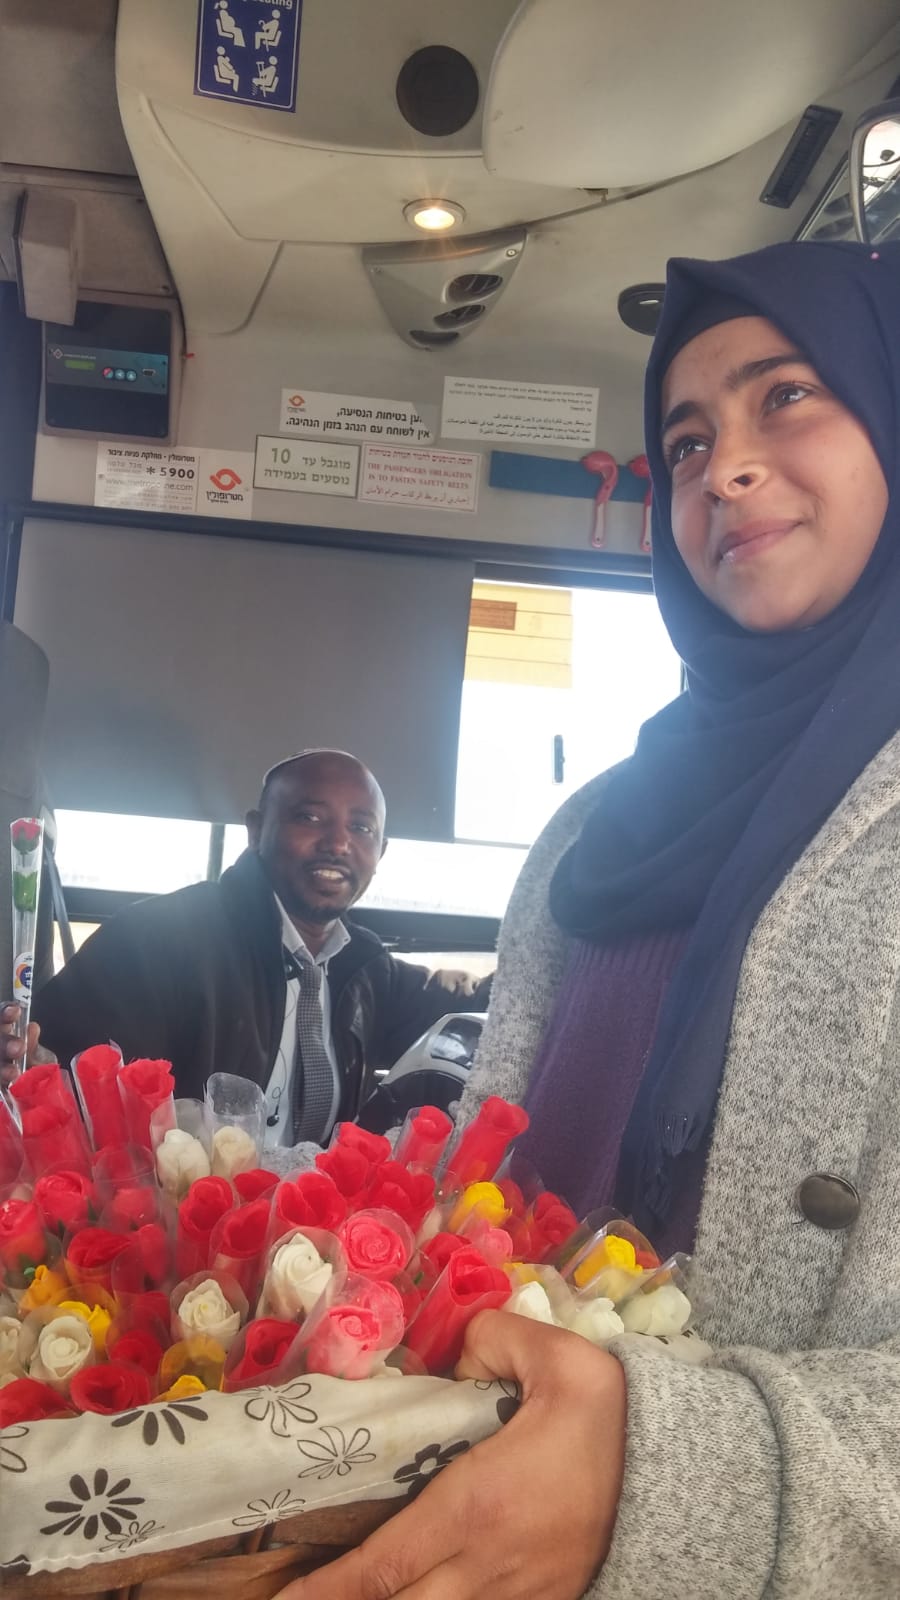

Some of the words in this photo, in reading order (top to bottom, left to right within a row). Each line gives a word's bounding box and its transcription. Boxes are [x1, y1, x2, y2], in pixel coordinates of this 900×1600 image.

[336, 407, 373, 418] הנסיעה,
[375, 410, 407, 421] בטיחות
[286, 417, 320, 428] הנהיגה.
[323, 420, 342, 432] בזמן
[344, 422, 367, 432] הנהג
[370, 424, 383, 434] עם
[386, 426, 415, 437] לשוחח
[417, 430, 430, 440] אין
[271, 447, 291, 464] 10
[302, 456, 317, 466] עד
[320, 456, 351, 470] מוגבל
[367, 462, 380, 470] THE
[264, 468, 307, 481] בעמידה
[311, 473, 351, 485] נוסעים
[206, 490, 244, 502] מטרופולין
